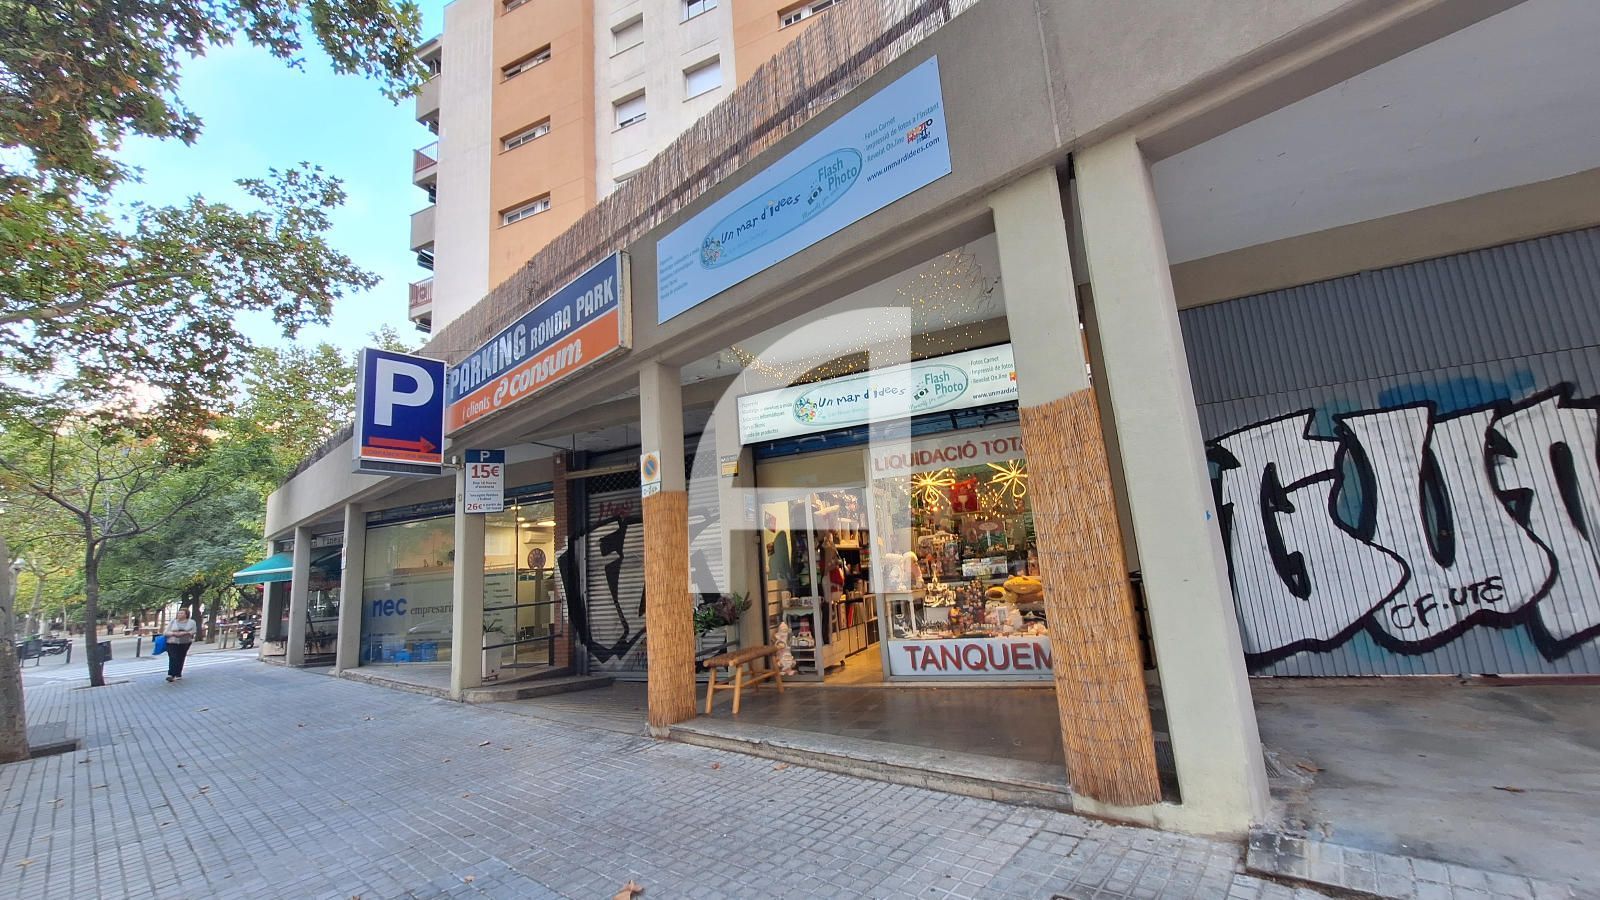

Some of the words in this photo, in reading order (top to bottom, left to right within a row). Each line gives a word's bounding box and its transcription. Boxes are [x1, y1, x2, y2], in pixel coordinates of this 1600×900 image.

[818, 157, 843, 182] Flash
[866, 136, 940, 182] www.unmardidees.com
[828, 166, 858, 190] Photo
[722, 232, 734, 244] Un
[736, 217, 758, 236] mar
[450, 324, 526, 399] PARKING
[531, 305, 571, 350] RONDA
[576, 275, 614, 322] PARK
[925, 370, 950, 385] Flash
[935, 382, 964, 395] Photo
[374, 358, 434, 426] P
[819, 397, 832, 408] Un
[836, 394, 860, 406] mar
[466, 397, 490, 418] clients
[480, 450, 490, 462] P
[875, 440, 978, 471] LIQUIDACIÓ
[472, 464, 500, 478] 15€
[372, 598, 407, 618] nec
